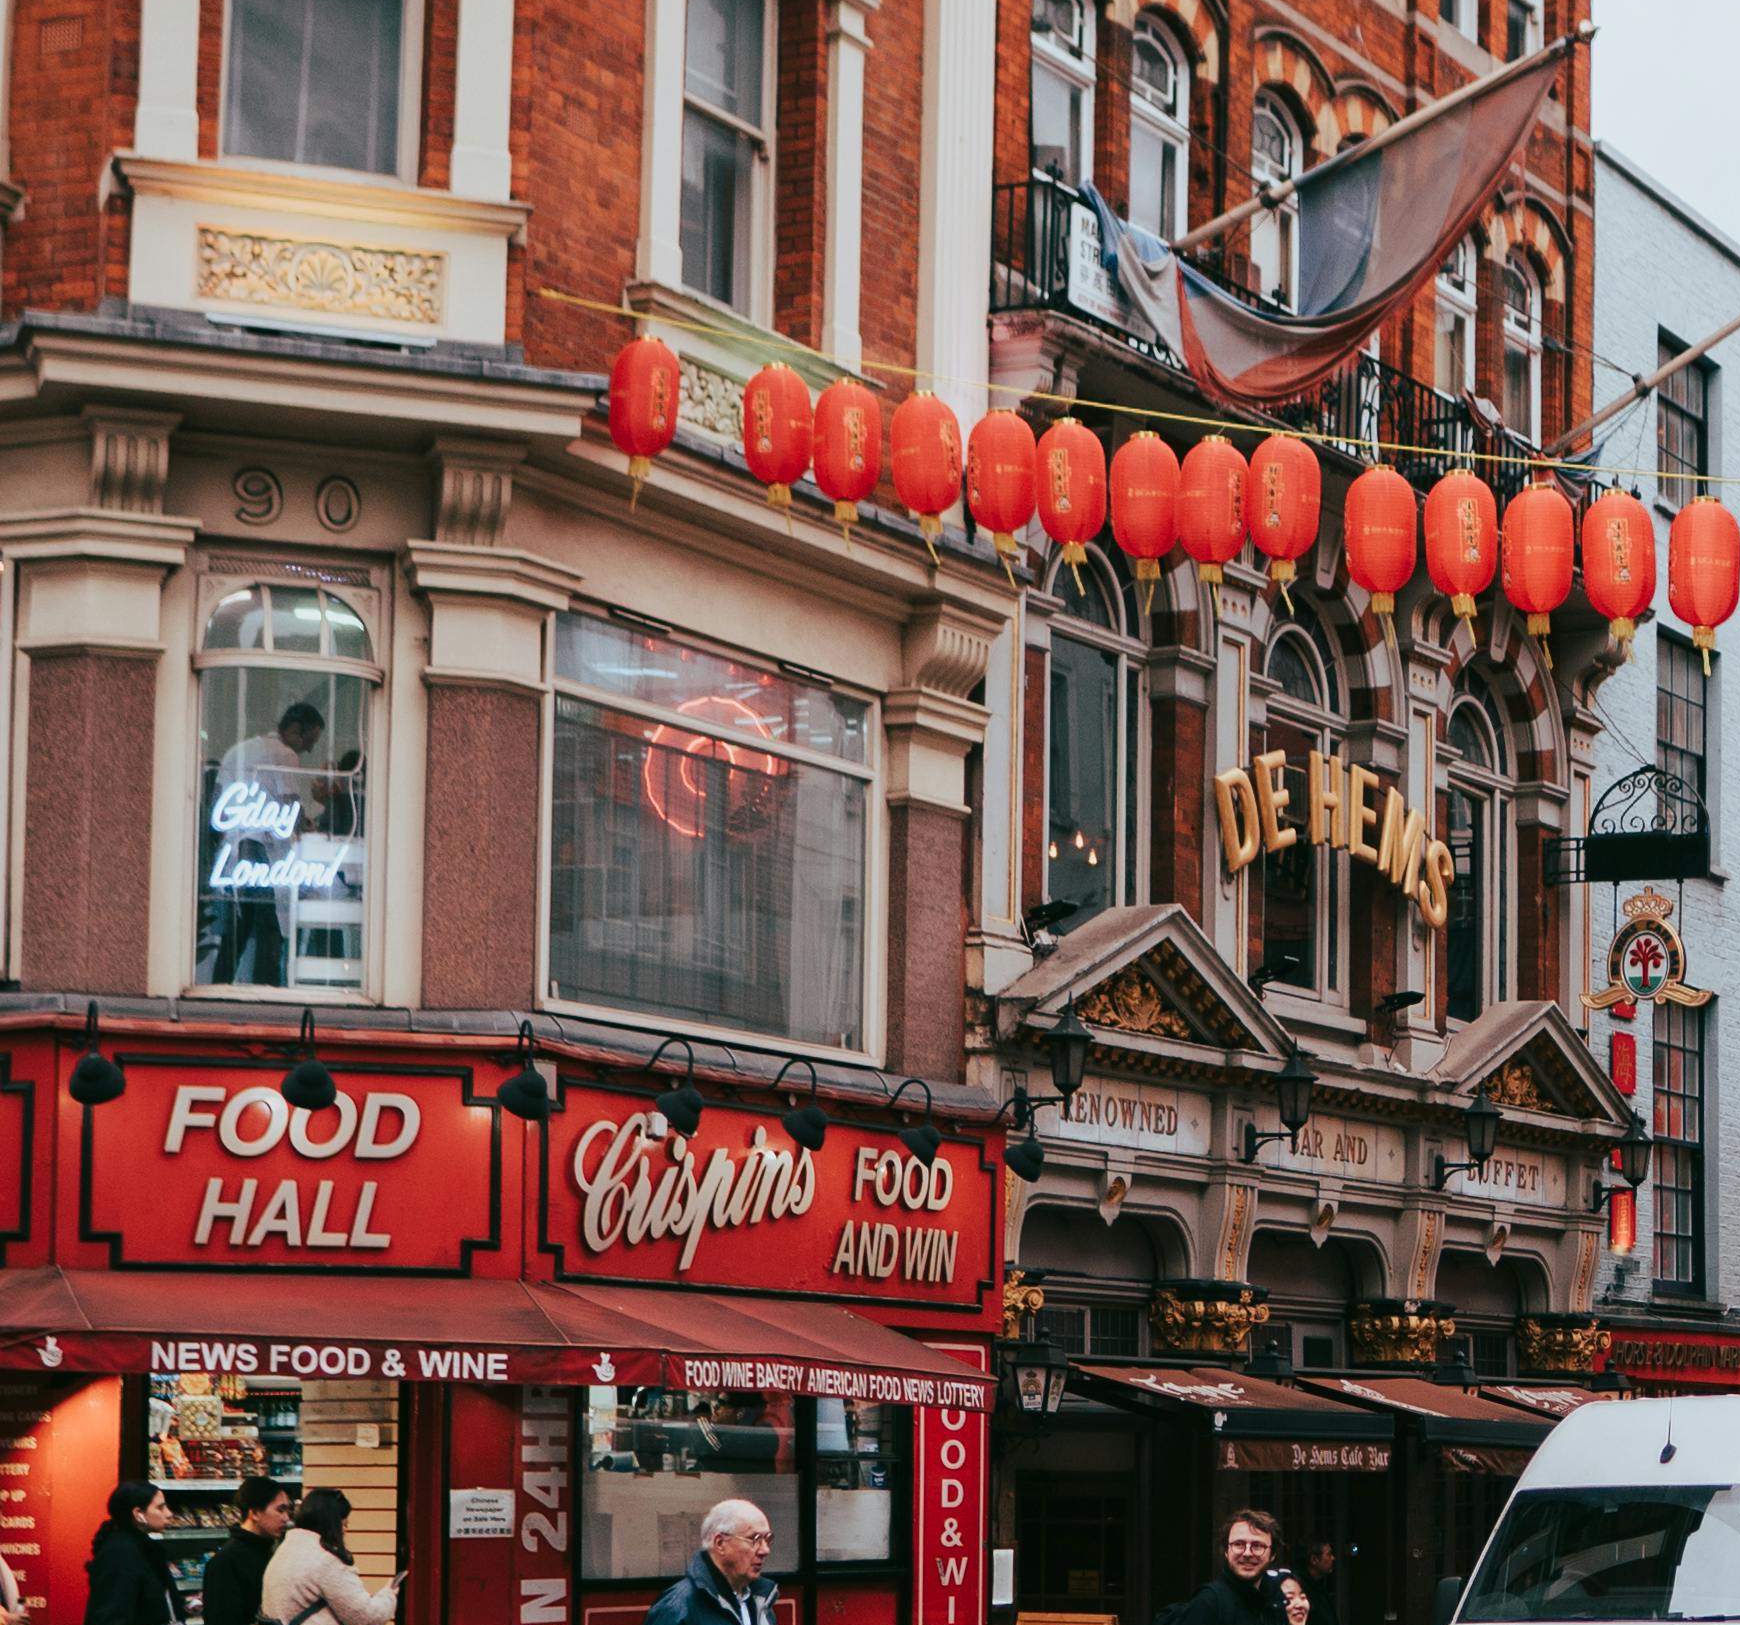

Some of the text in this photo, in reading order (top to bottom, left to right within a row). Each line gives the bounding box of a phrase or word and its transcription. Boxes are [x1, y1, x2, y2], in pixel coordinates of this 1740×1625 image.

[211, 781, 300, 840] G'day
[1214, 749, 1455, 927] DE HEMS
[164, 1085, 421, 1160] FOOD
[1332, 1132, 1369, 1166] AND
[574, 1112, 816, 1272] Crispins
[855, 1146, 954, 1212] FOOD
[194, 1177, 391, 1248] HALL
[833, 1219, 960, 1284] AND WIN
[151, 1341, 509, 1381] NEWS FOOD & WINE
[685, 1360, 986, 1409] FOOD WINE BAKERY AMERICAN FOOD NEWS LOTTERY
[1367, 1446, 1390, 1469] Bar
